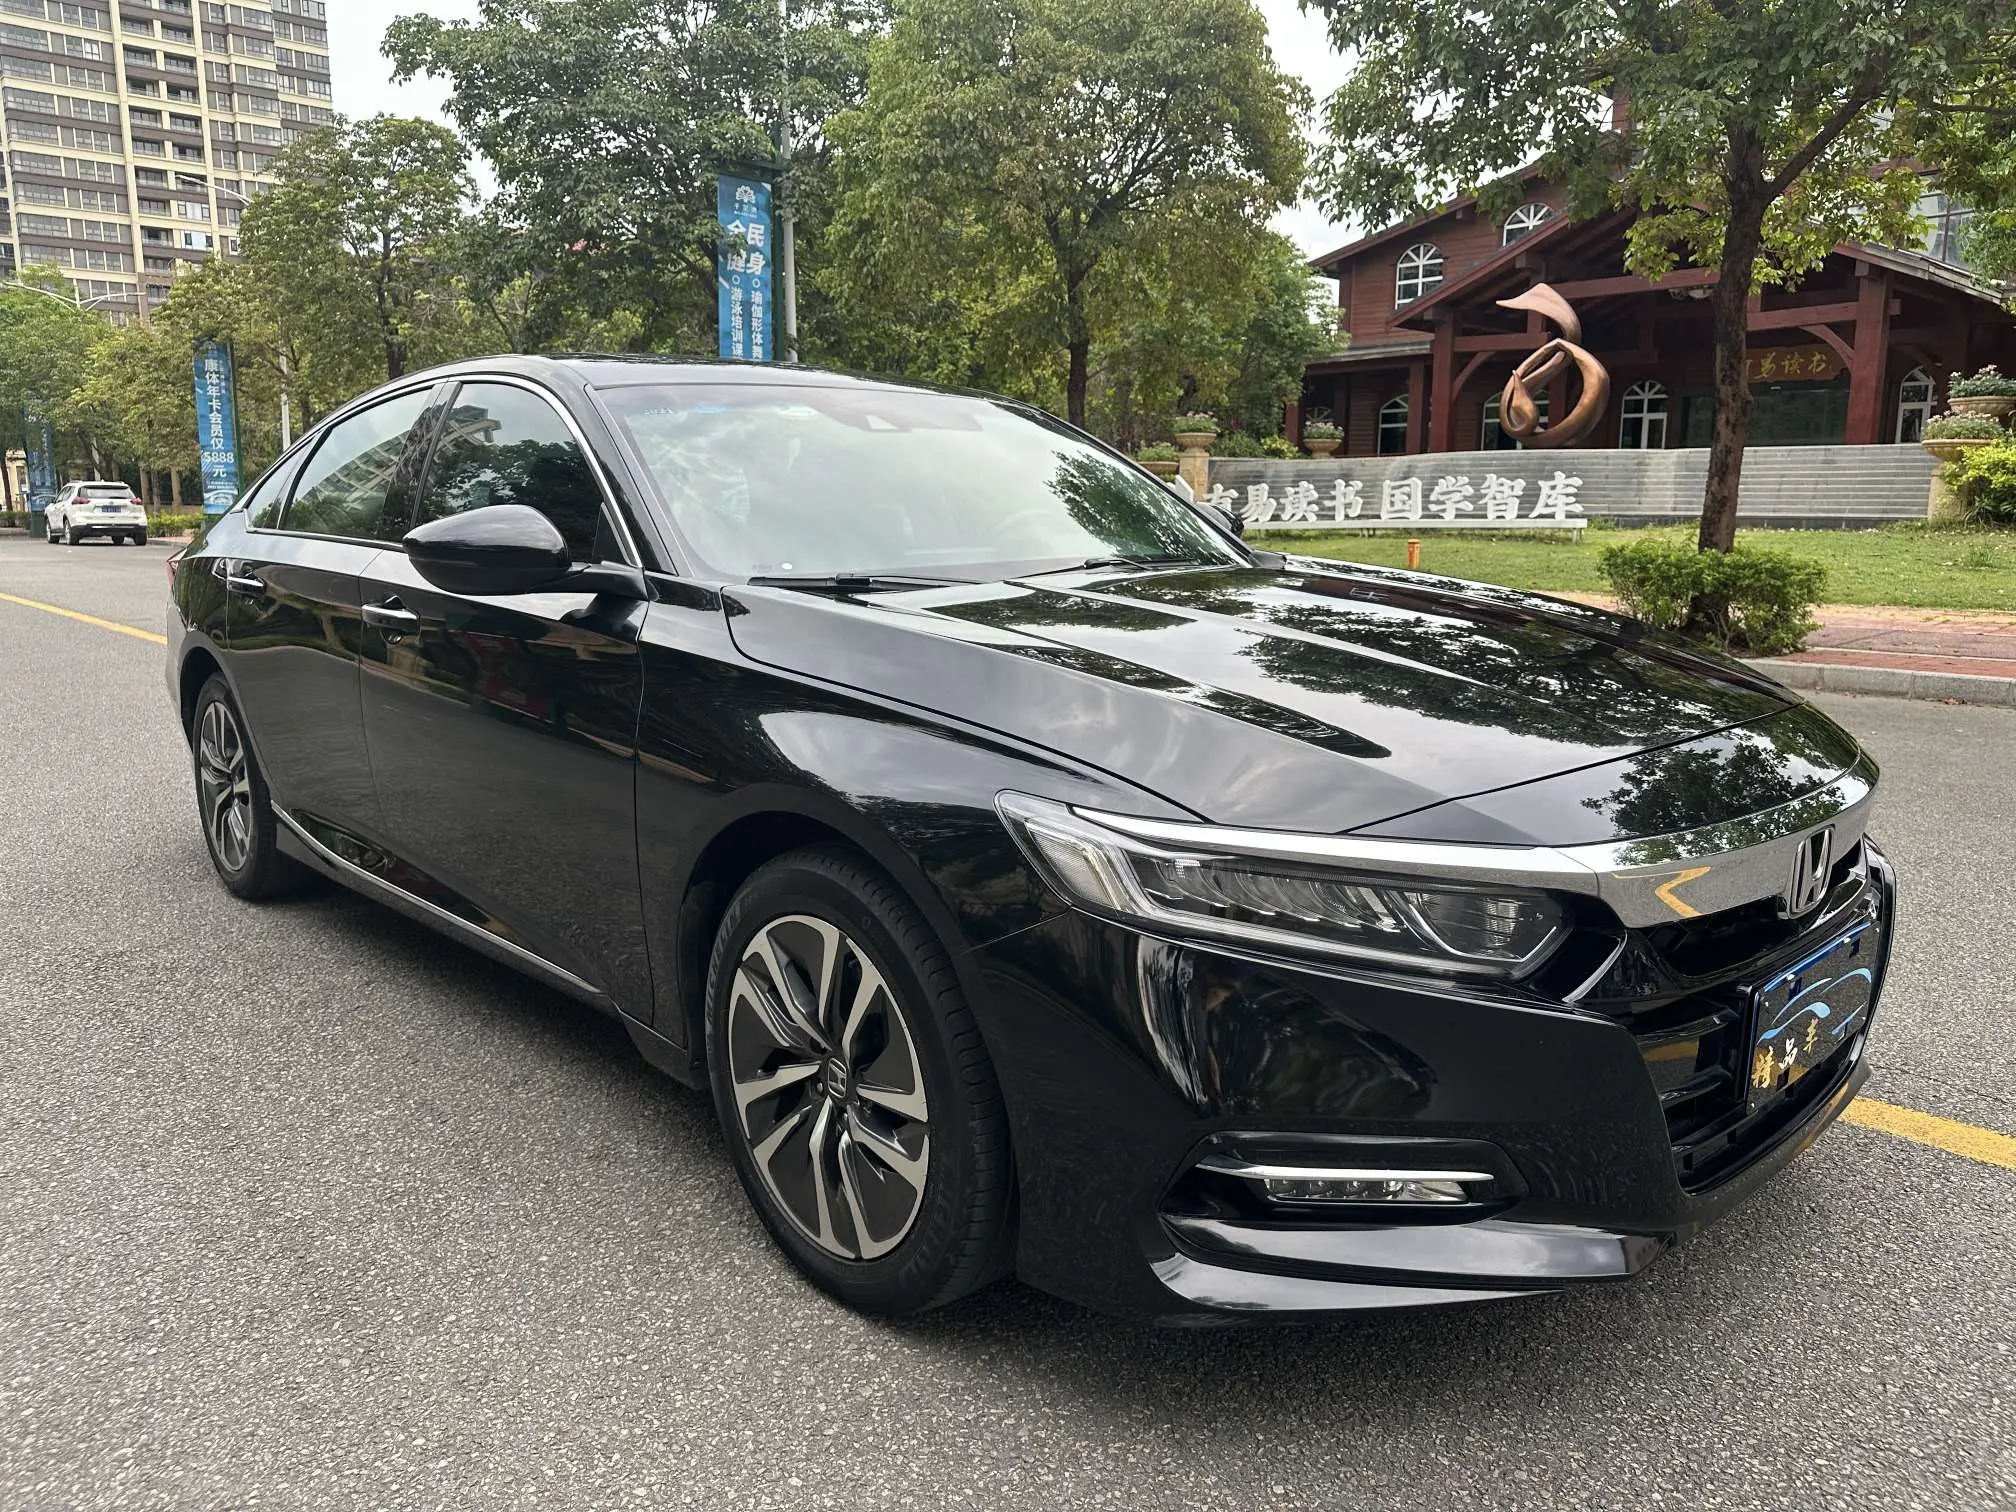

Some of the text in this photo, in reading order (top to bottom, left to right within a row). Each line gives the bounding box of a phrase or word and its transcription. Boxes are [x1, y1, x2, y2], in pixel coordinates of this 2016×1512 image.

[1745, 351, 1827, 379] 易读书
[205, 359, 225, 450] 康体年卡会员仅
[204, 451, 235, 464] 5888
[212, 464, 228, 478] 元
[1165, 470, 1585, 522] 有易读书 国学智库
